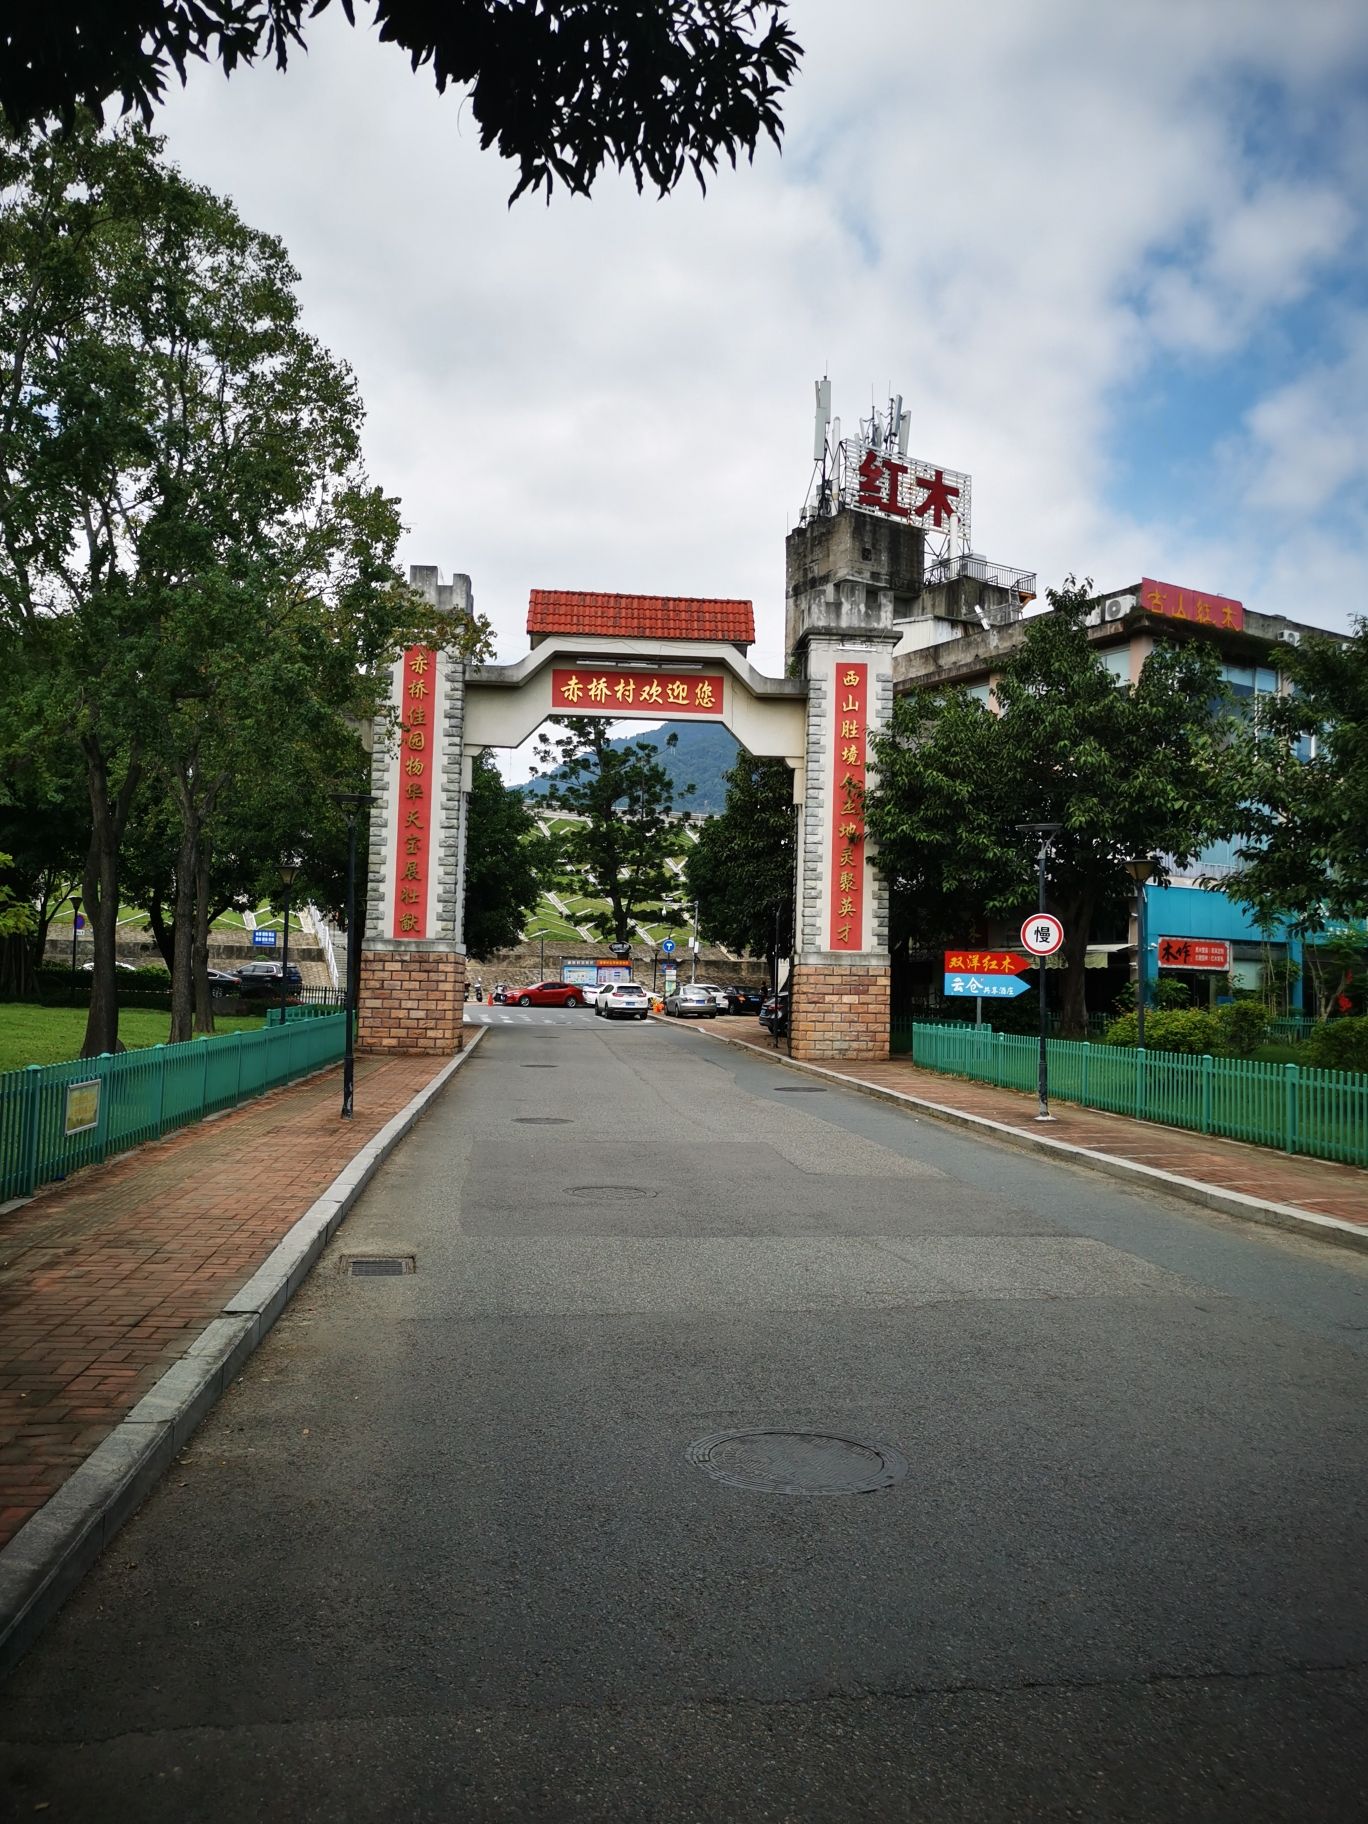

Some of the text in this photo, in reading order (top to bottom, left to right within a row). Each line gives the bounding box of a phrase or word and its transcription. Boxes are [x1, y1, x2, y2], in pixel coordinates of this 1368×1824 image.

[858, 449, 961, 527] 红木
[560, 674, 716, 708] 赤桥村欢迎您
[1034, 926, 1051, 944] 慢
[949, 955, 1015, 972] 双洋红木
[951, 977, 983, 994] 云仓
